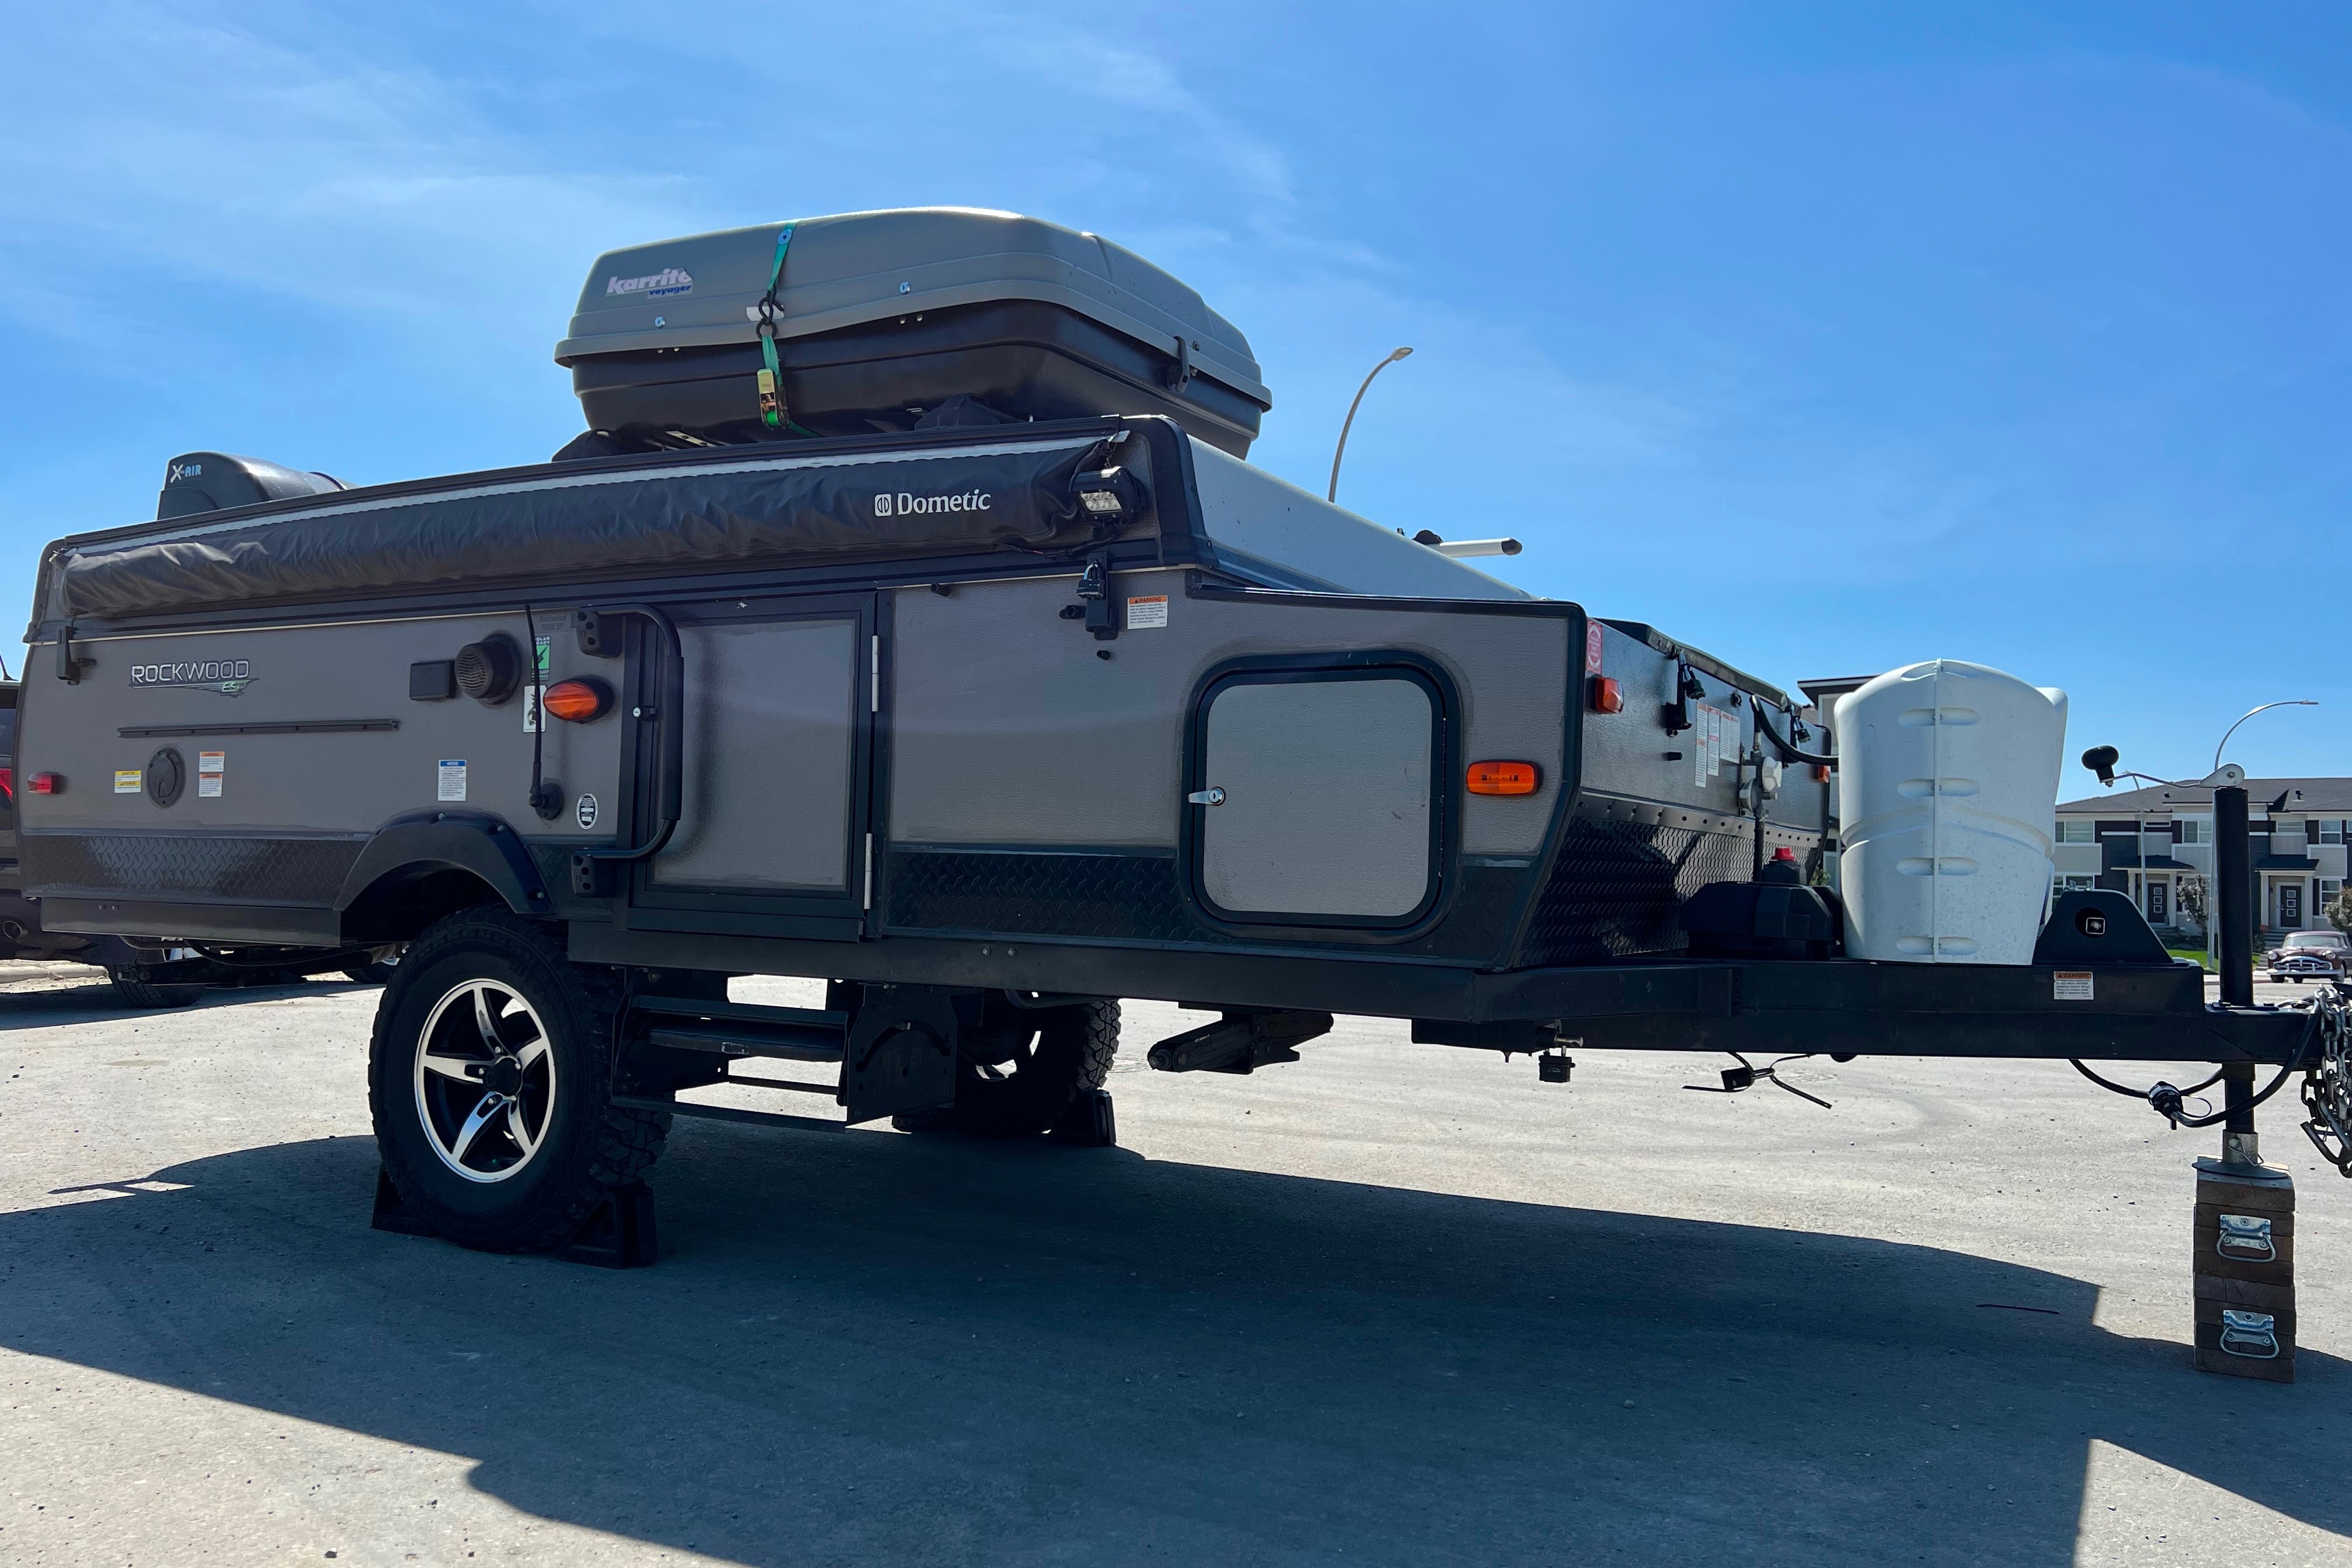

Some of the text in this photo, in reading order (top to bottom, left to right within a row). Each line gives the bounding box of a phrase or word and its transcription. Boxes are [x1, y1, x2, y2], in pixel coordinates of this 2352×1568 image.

[170, 464, 201, 483] X-AIR
[897, 489, 991, 515] Dometic
[132, 661, 249, 683] ROCKWOOD
[222, 681, 247, 692] ESP
